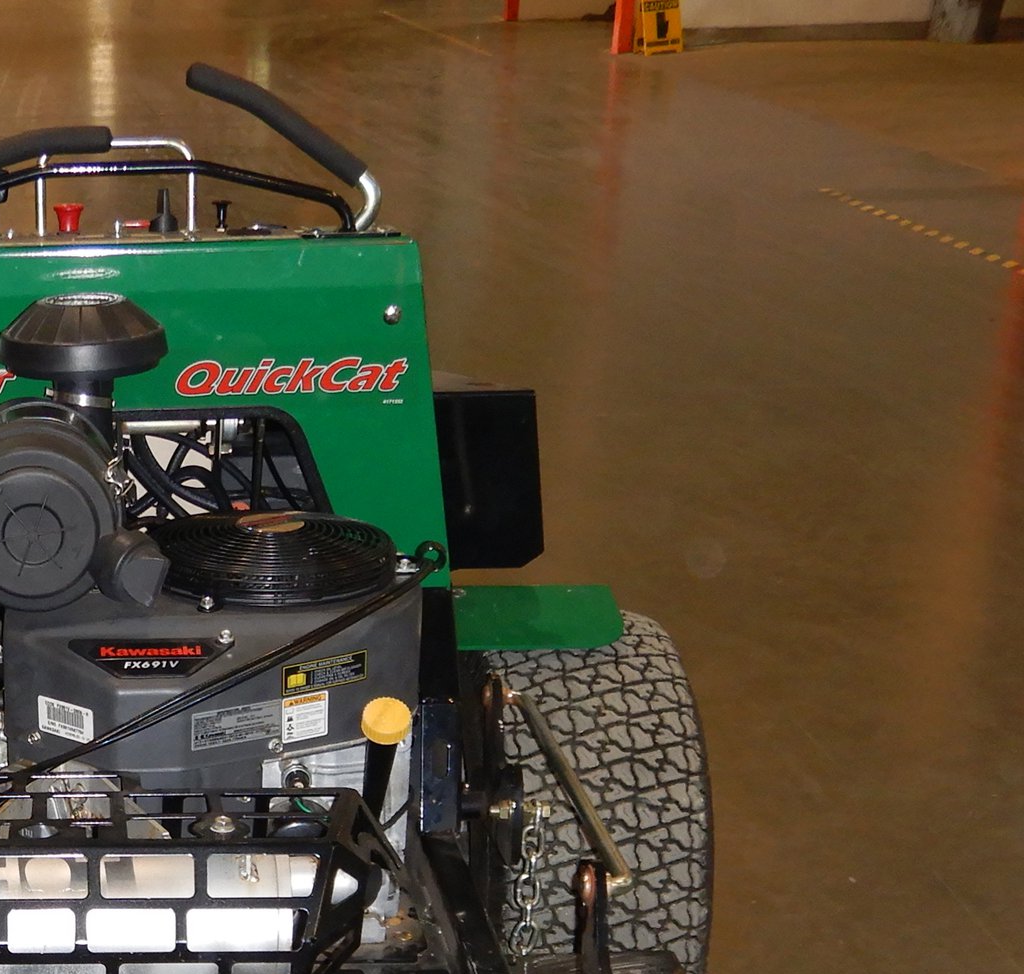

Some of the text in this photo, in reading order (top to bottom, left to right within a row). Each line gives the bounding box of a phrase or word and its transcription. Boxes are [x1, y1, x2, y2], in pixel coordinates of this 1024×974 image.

[175, 357, 408, 396] QuickCat
[99, 645, 202, 657] Kawasaki
[123, 660, 179, 669] FX691V
[293, 694, 322, 705] WARNING
